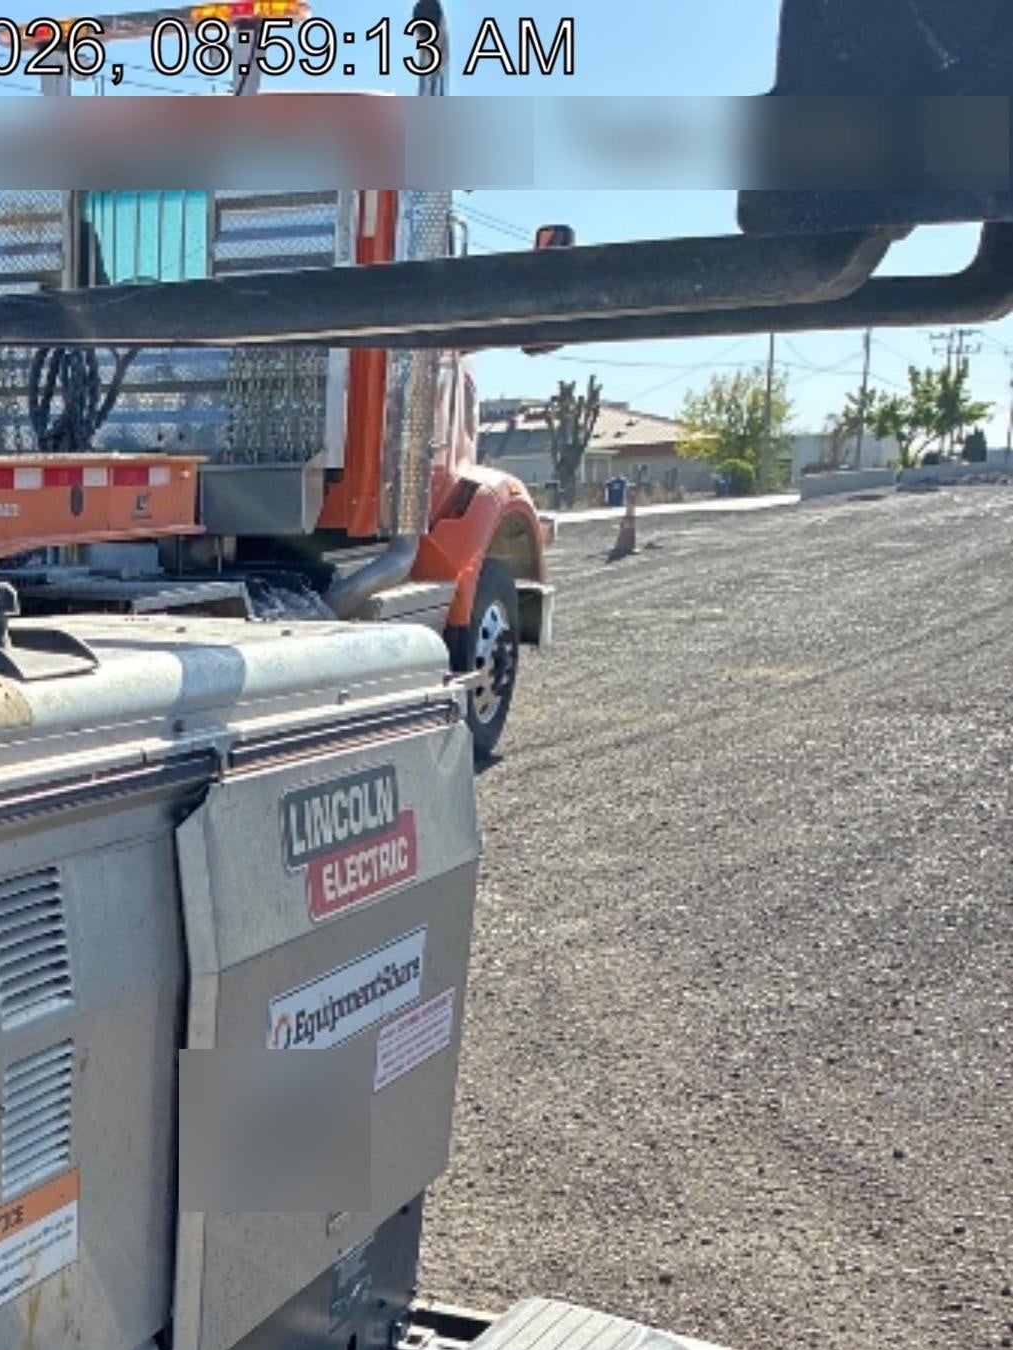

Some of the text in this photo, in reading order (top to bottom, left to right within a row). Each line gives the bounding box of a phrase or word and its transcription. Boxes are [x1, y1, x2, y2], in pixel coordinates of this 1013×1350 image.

[289, 776, 394, 856] LINCOLN
[322, 836, 409, 902] ELECTRIC
[293, 956, 421, 1046] EquipmentShare
